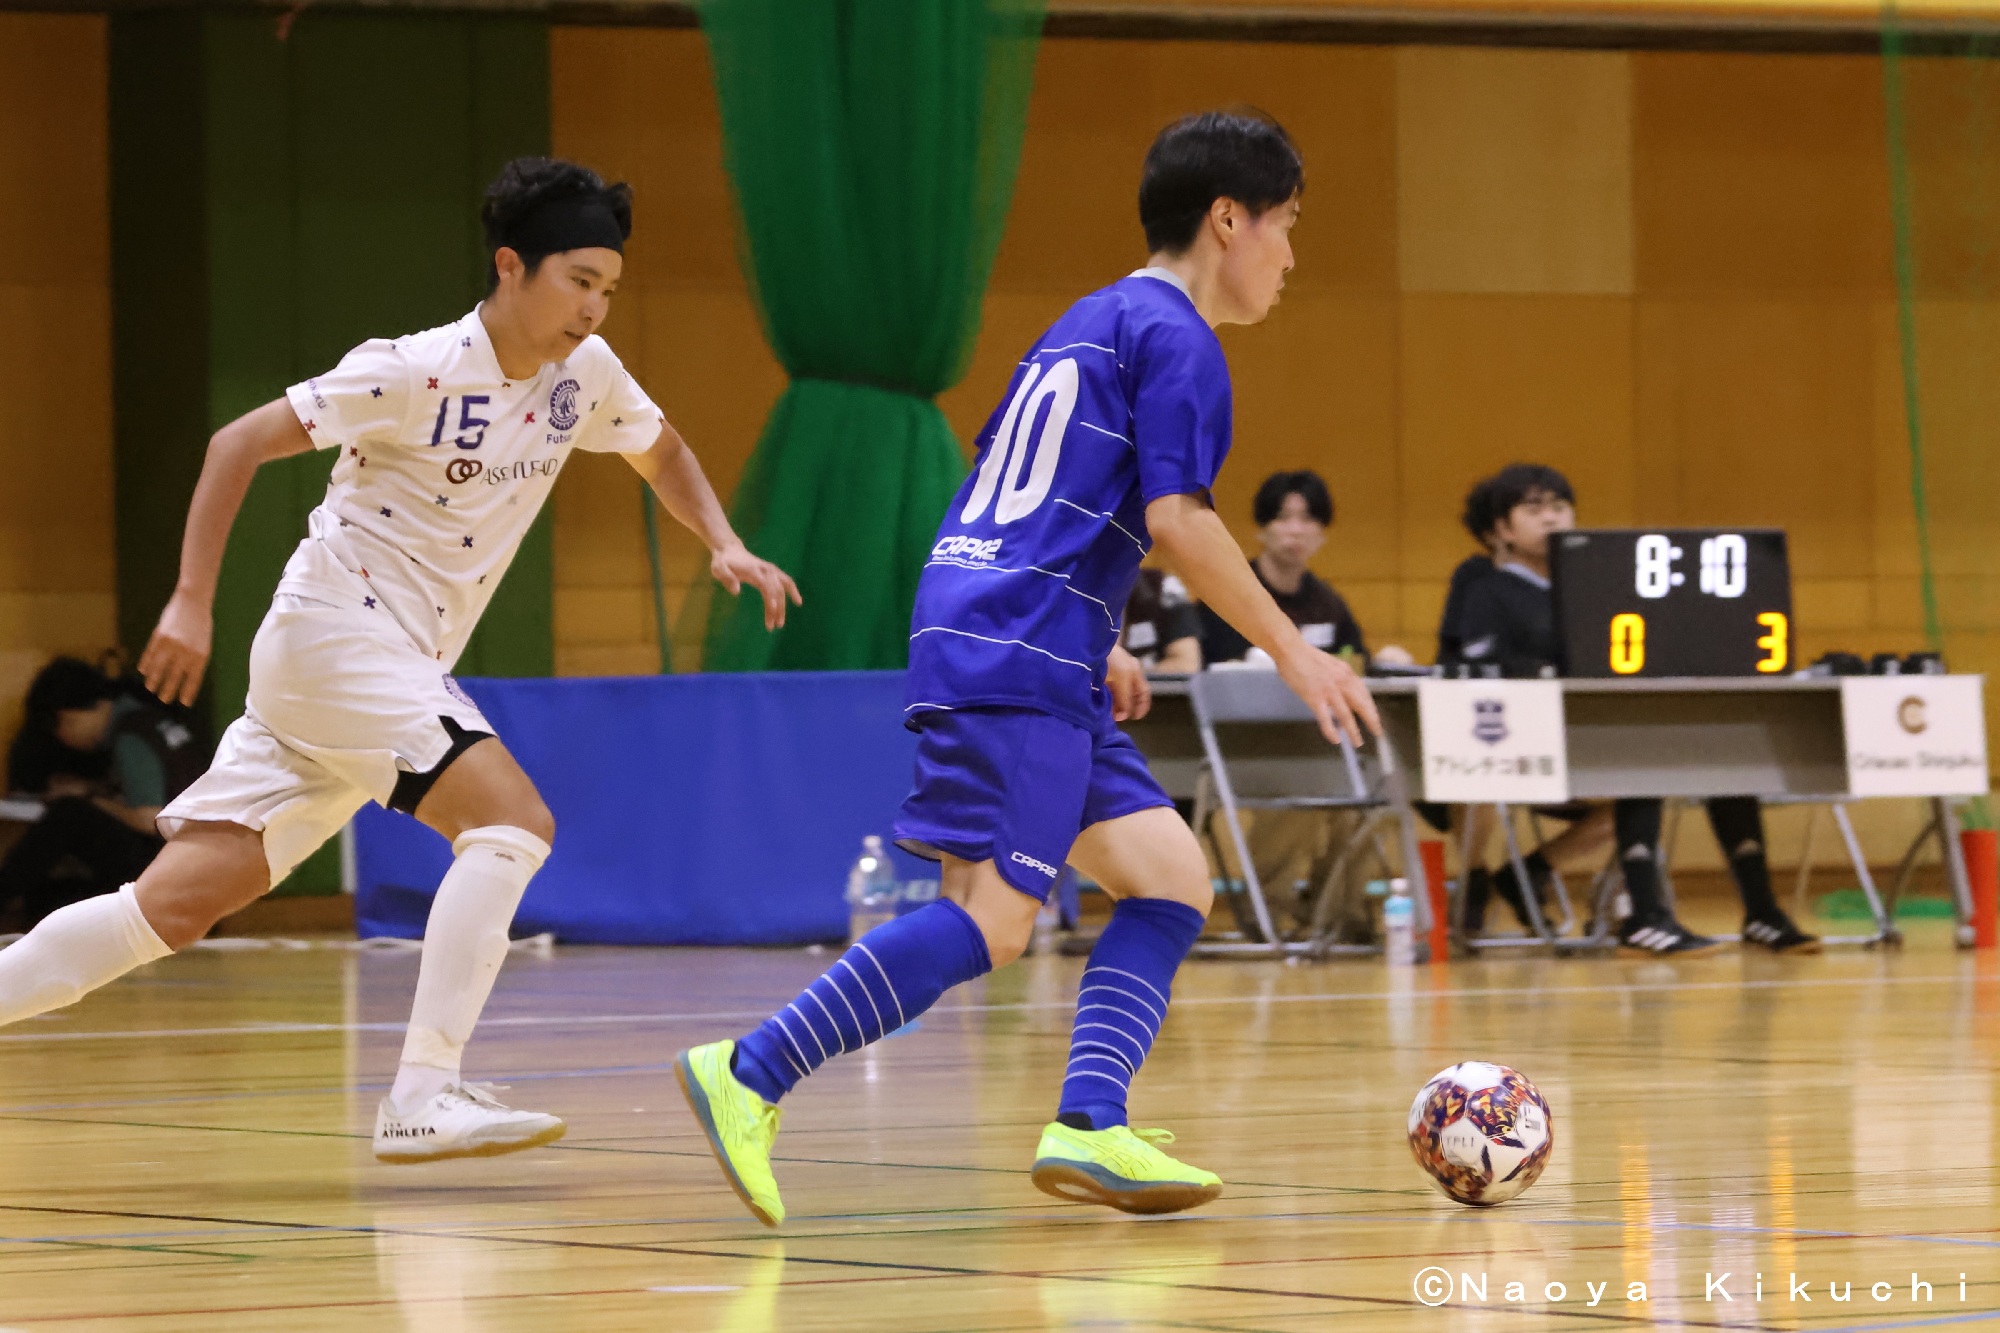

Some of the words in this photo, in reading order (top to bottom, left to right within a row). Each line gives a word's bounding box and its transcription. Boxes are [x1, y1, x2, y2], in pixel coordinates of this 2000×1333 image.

[431, 394, 491, 451] 15
[960, 357, 1080, 525] 10
[1610, 613, 1645, 674] 0
[1756, 612, 1787, 672] 3
[382, 1126, 436, 1138] ATHLETA
